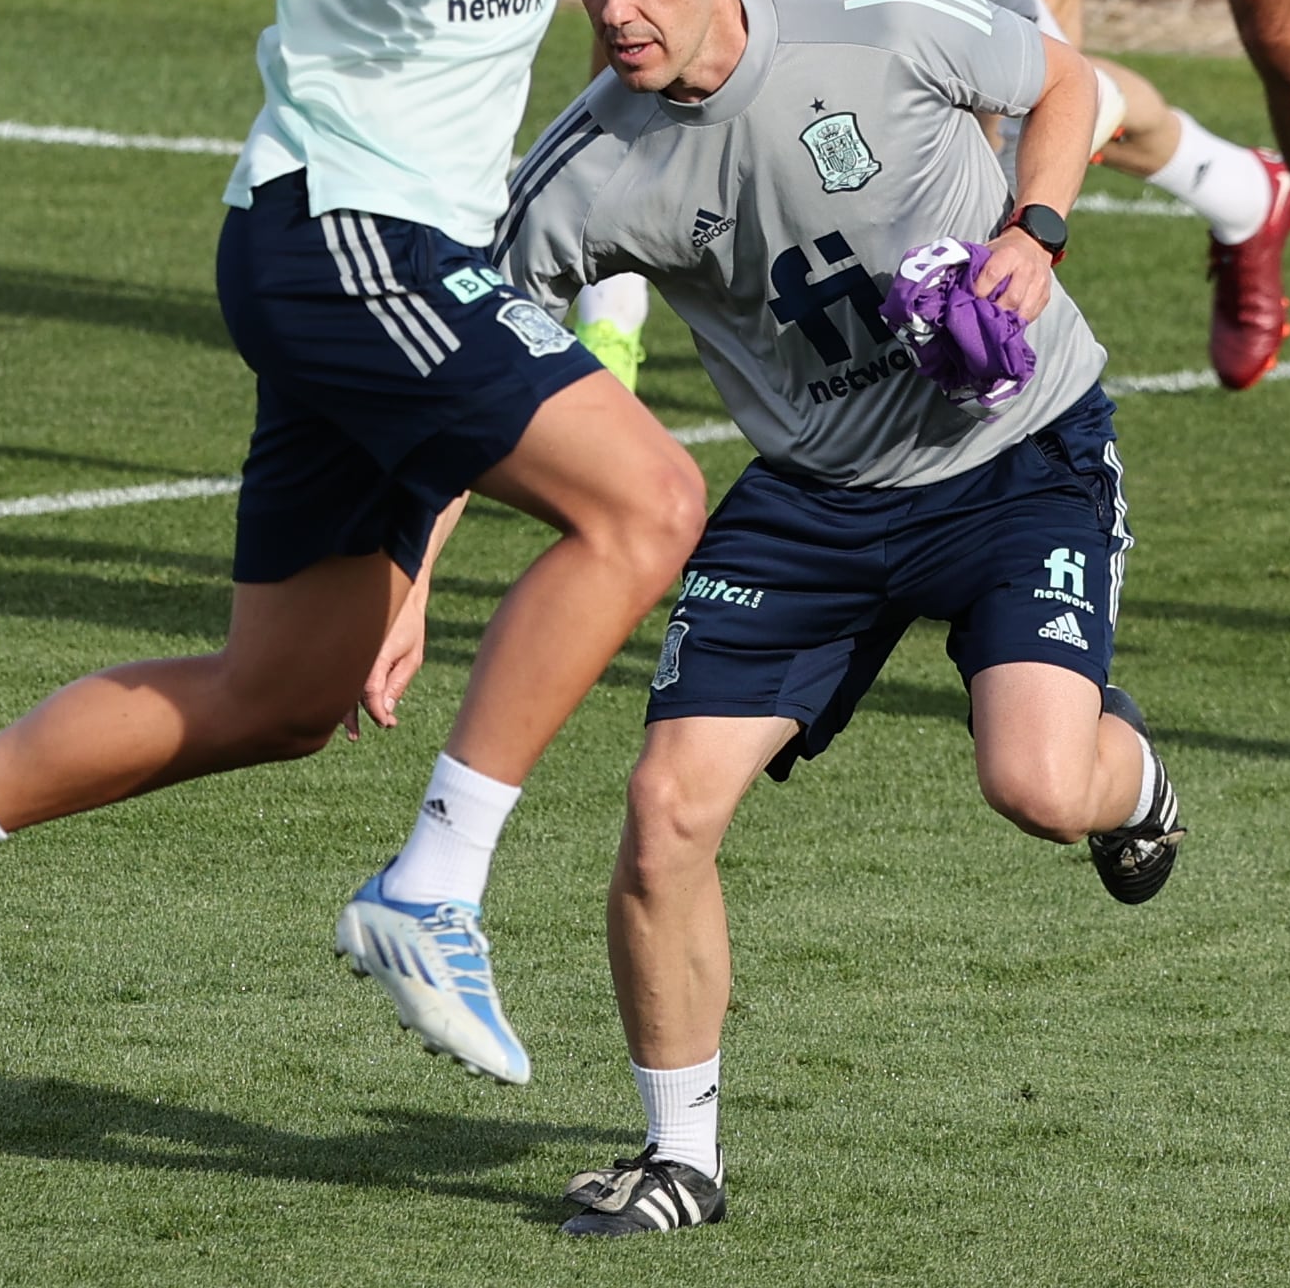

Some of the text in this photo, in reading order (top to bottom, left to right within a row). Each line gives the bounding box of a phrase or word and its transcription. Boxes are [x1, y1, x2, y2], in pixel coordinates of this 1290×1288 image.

[692, 217, 736, 248] adidas
[767, 230, 896, 367] fi
[807, 348, 911, 405] netwo
[1043, 547, 1086, 598] fi
[1033, 588, 1095, 615] network
[1037, 626, 1089, 651] adidas
